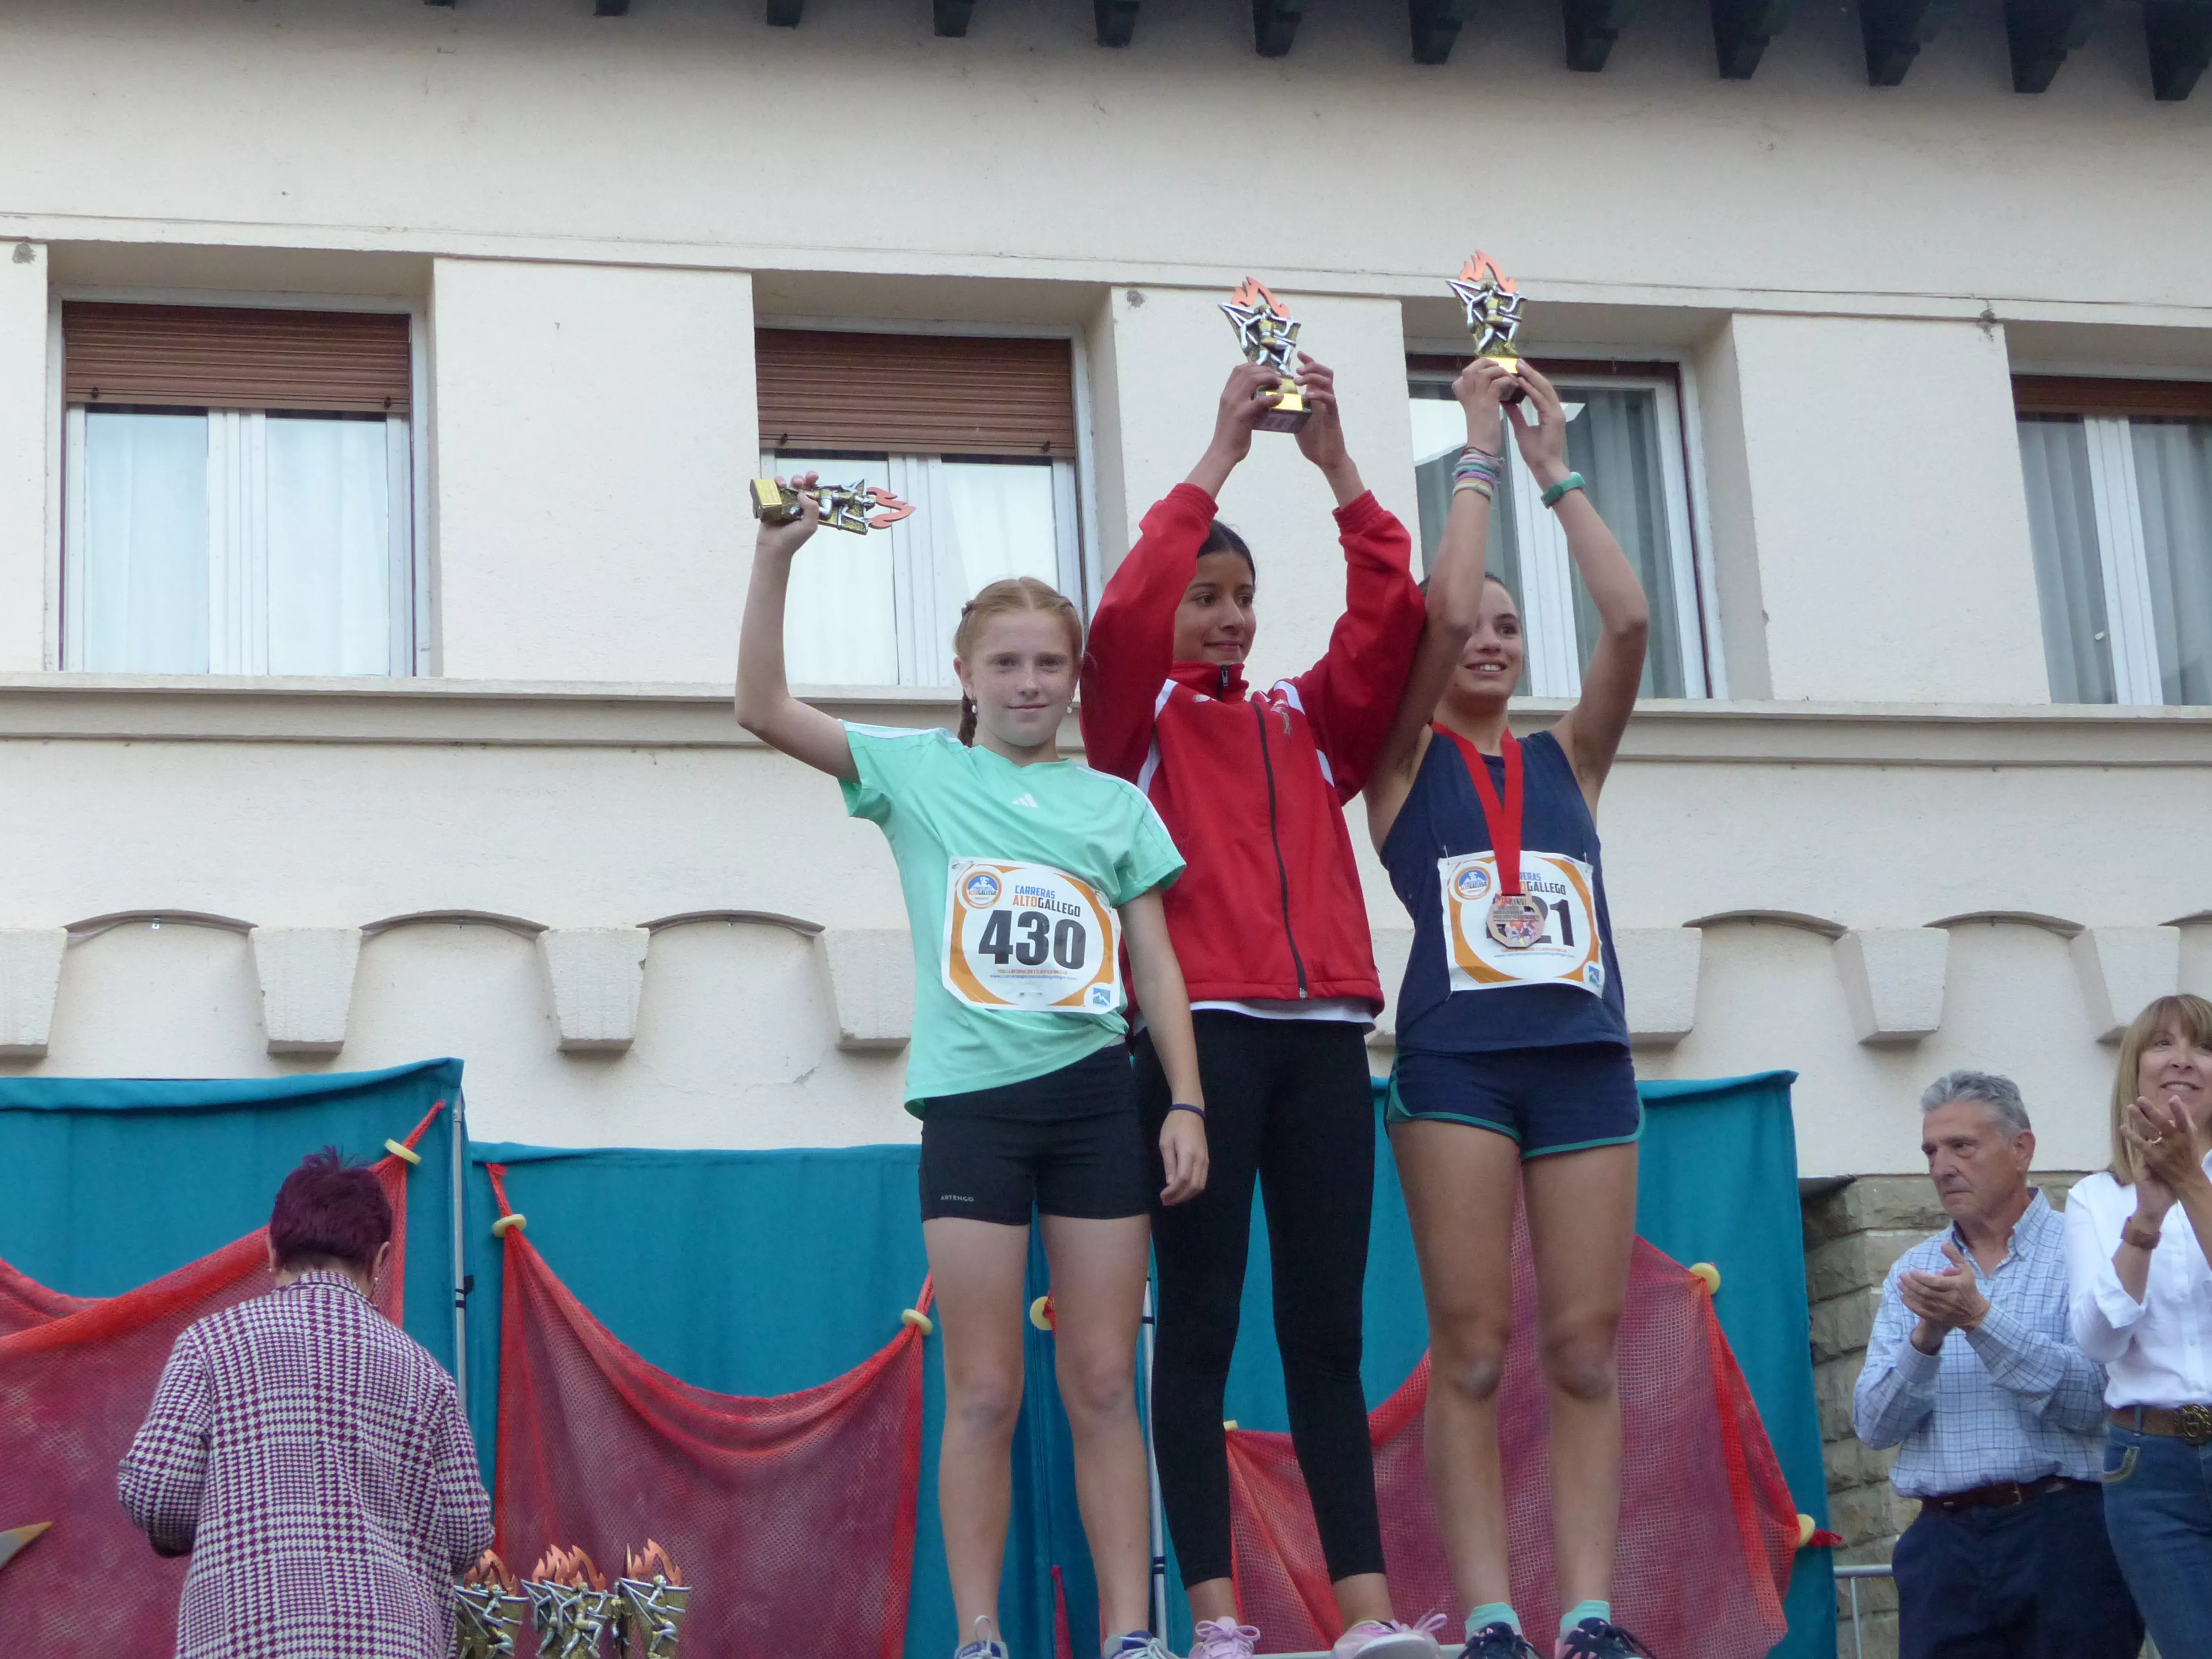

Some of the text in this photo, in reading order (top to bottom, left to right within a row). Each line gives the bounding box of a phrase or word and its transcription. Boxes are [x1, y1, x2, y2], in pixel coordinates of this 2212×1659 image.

[1015, 885, 1055, 899] CARRERAS
[1013, 895, 1081, 917] ALTOGALLEGO
[978, 909, 1087, 970] 430
